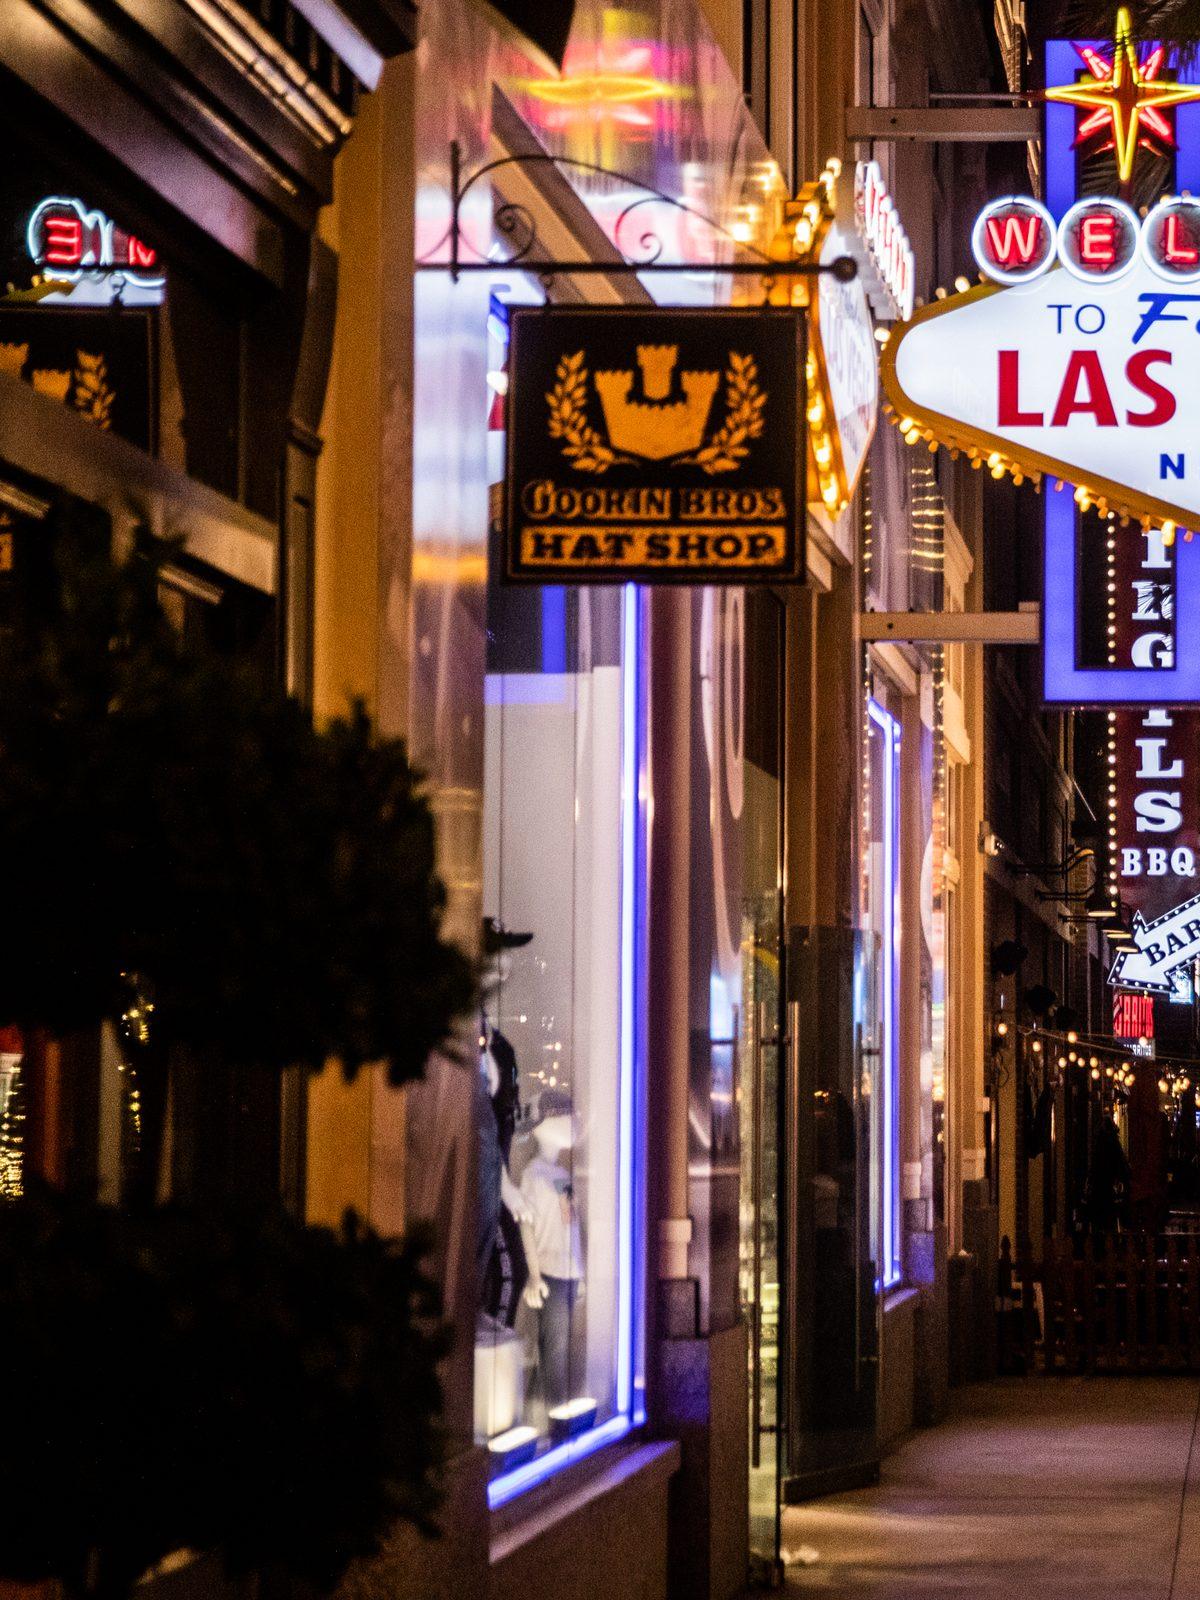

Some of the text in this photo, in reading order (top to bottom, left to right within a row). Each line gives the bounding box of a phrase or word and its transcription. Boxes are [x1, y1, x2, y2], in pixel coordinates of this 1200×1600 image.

[1047, 303, 1106, 335] TO
[997, 348, 1178, 428] LAS
[521, 479, 671, 519] GOORIN
[531, 533, 777, 560] HAT SHOP
[1120, 847, 1196, 877] BBQ
